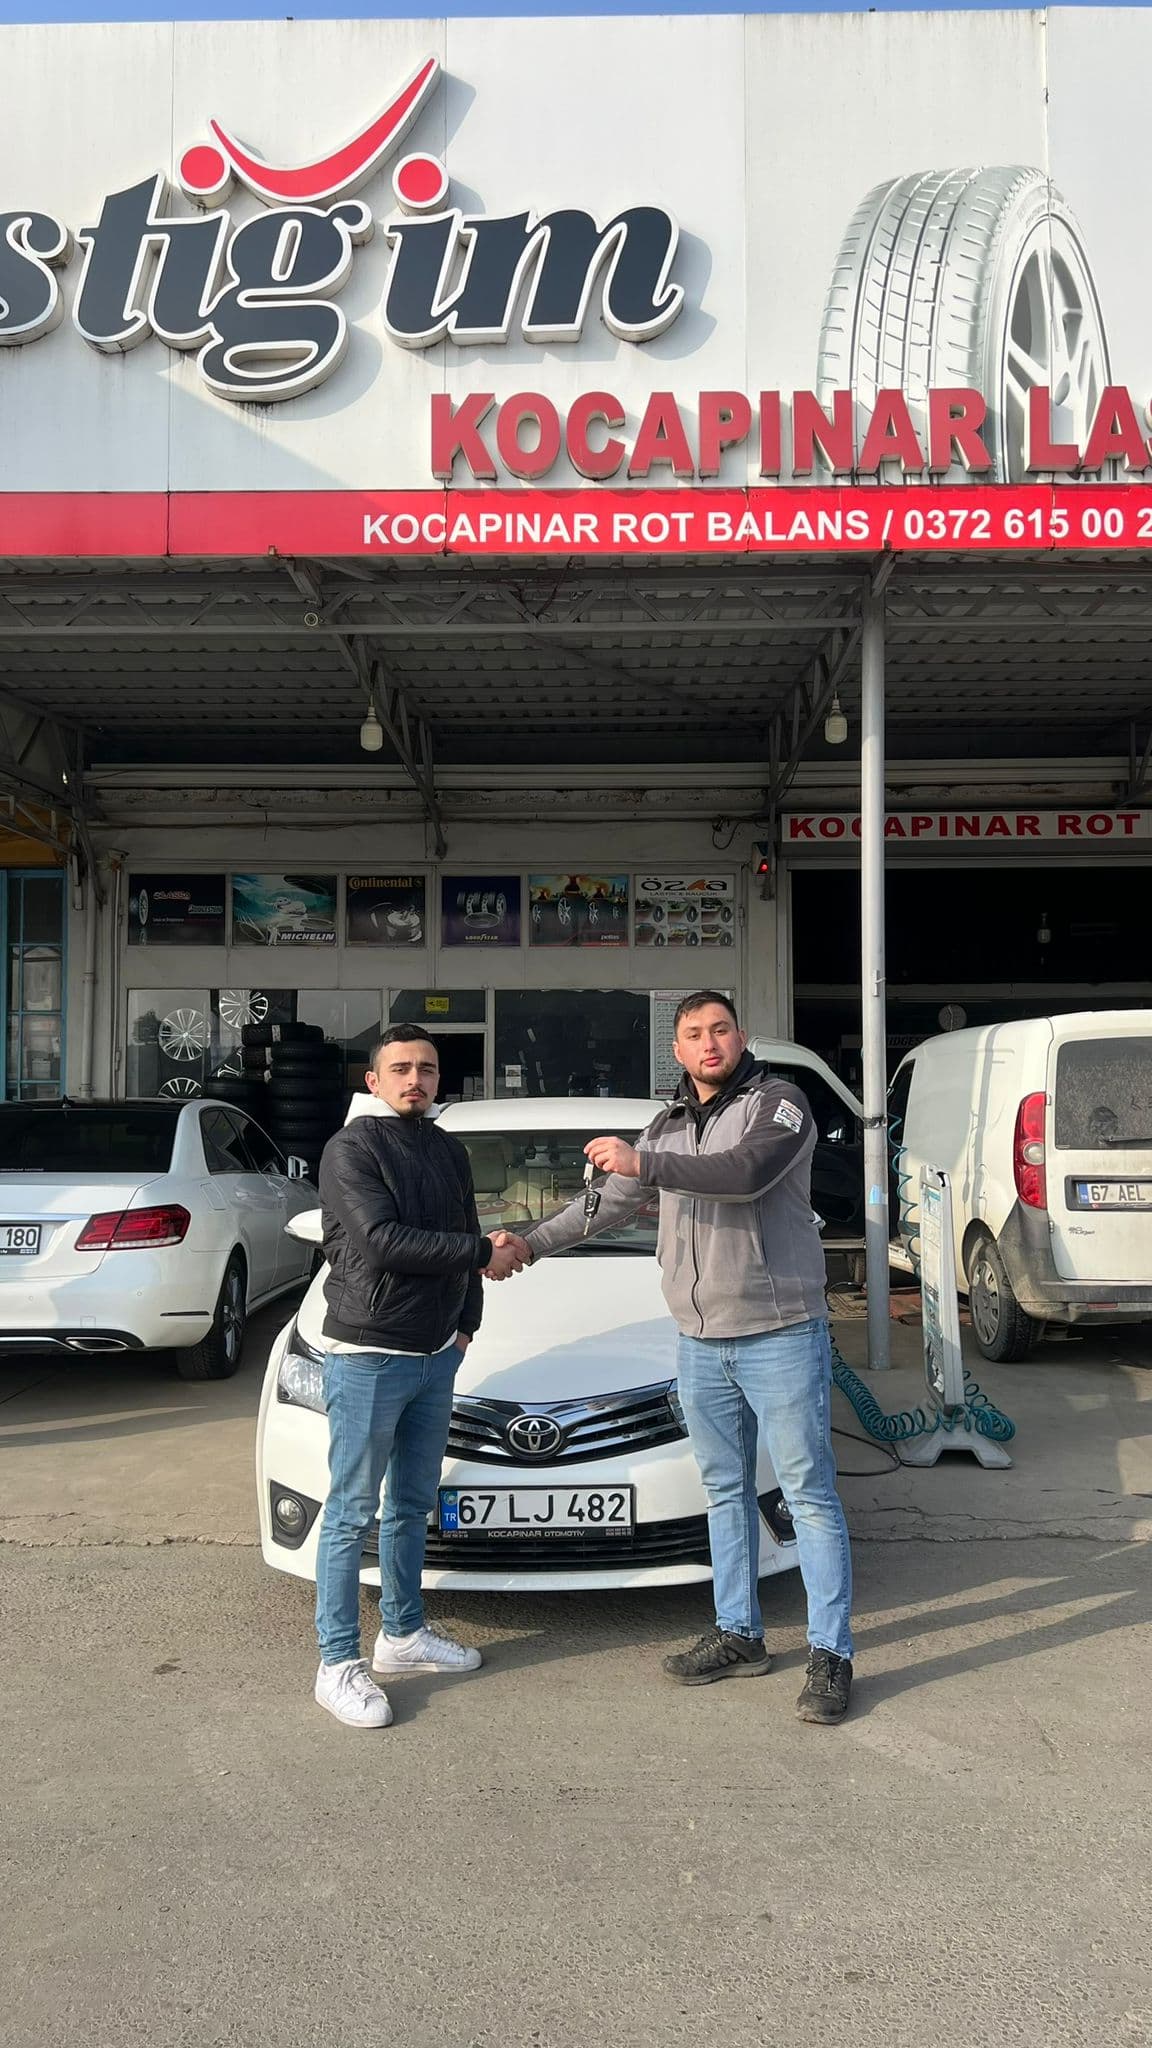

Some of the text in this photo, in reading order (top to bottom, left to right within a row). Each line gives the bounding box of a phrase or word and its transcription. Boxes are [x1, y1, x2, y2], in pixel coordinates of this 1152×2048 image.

[429, 385, 1152, 481] KOCAPINAR LA
[362, 512, 599, 544] KOCAPINAR
[612, 511, 694, 543] ROT
[707, 509, 869, 541] BALANS
[881, 509, 893, 542] /
[903, 508, 991, 540] 0372
[1004, 507, 1070, 539] 615
[1081, 507, 1124, 539] 00
[1057, 813, 1141, 836] ROT
[348, 876, 413, 890] Continental
[280, 932, 336, 942] MICHELIN
[1091, 1184, 1147, 1202] 67 AEL
[6, 1227, 37, 1247] 180
[444, 1511, 457, 1522] TR
[458, 1493, 626, 1524] 67 LJ 482
[487, 1529, 542, 1538] KOCAPINAR
